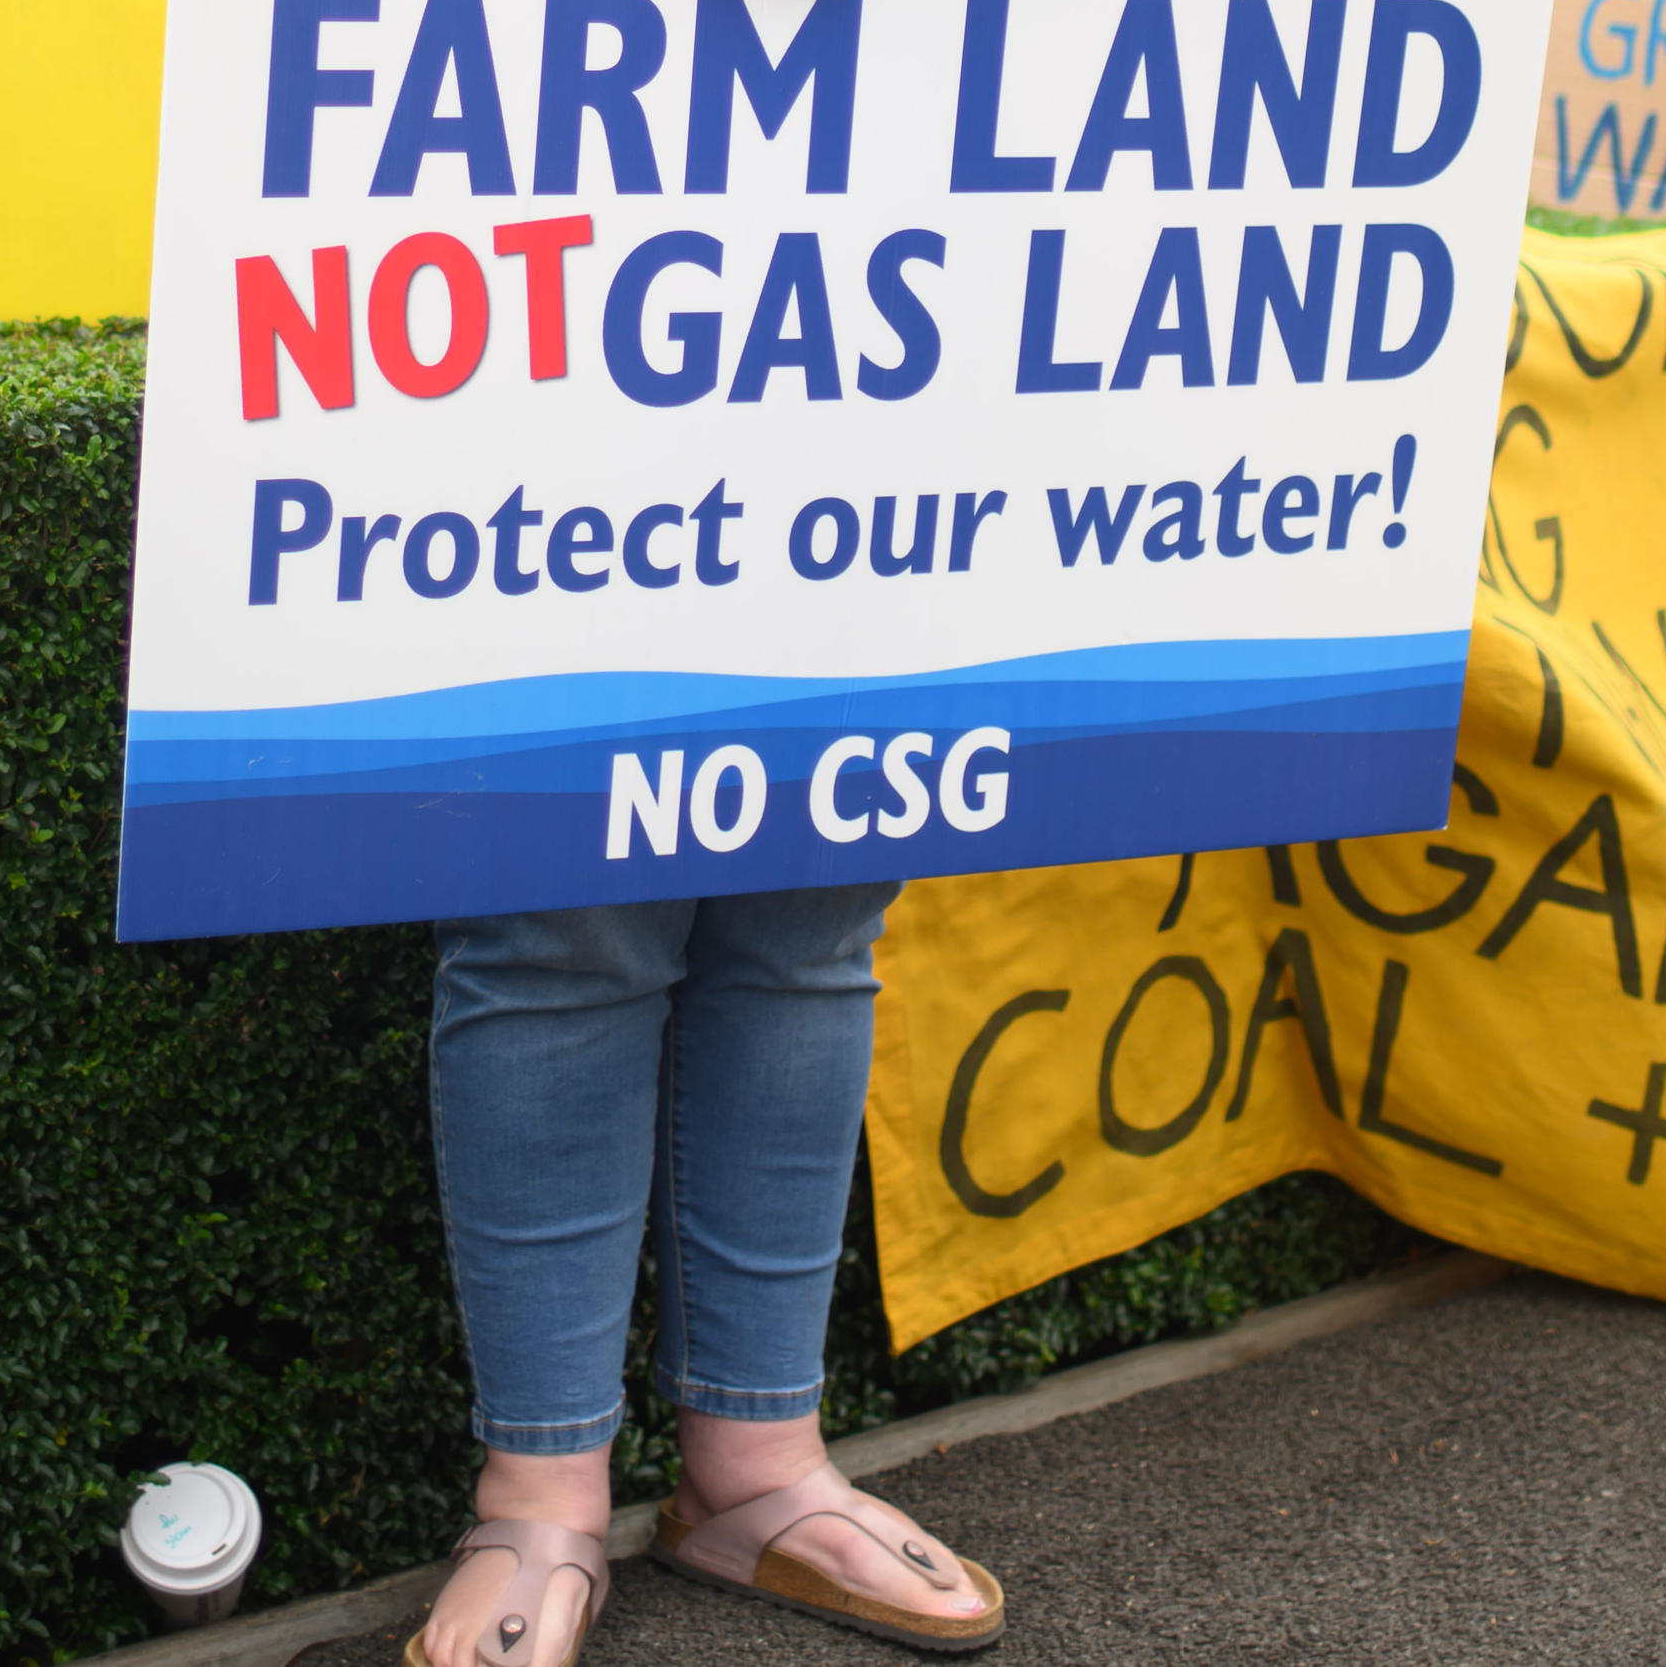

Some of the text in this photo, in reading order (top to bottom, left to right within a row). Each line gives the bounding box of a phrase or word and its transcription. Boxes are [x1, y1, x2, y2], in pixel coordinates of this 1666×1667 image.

[234, 213, 1455, 423] NOT GAS LAND
[248, 476, 742, 607] Protect
[788, 484, 1009, 586] our
[1047, 432, 1419, 571] water!
[605, 725, 1013, 861] NO CSG
[937, 928, 1504, 1219] COAL
